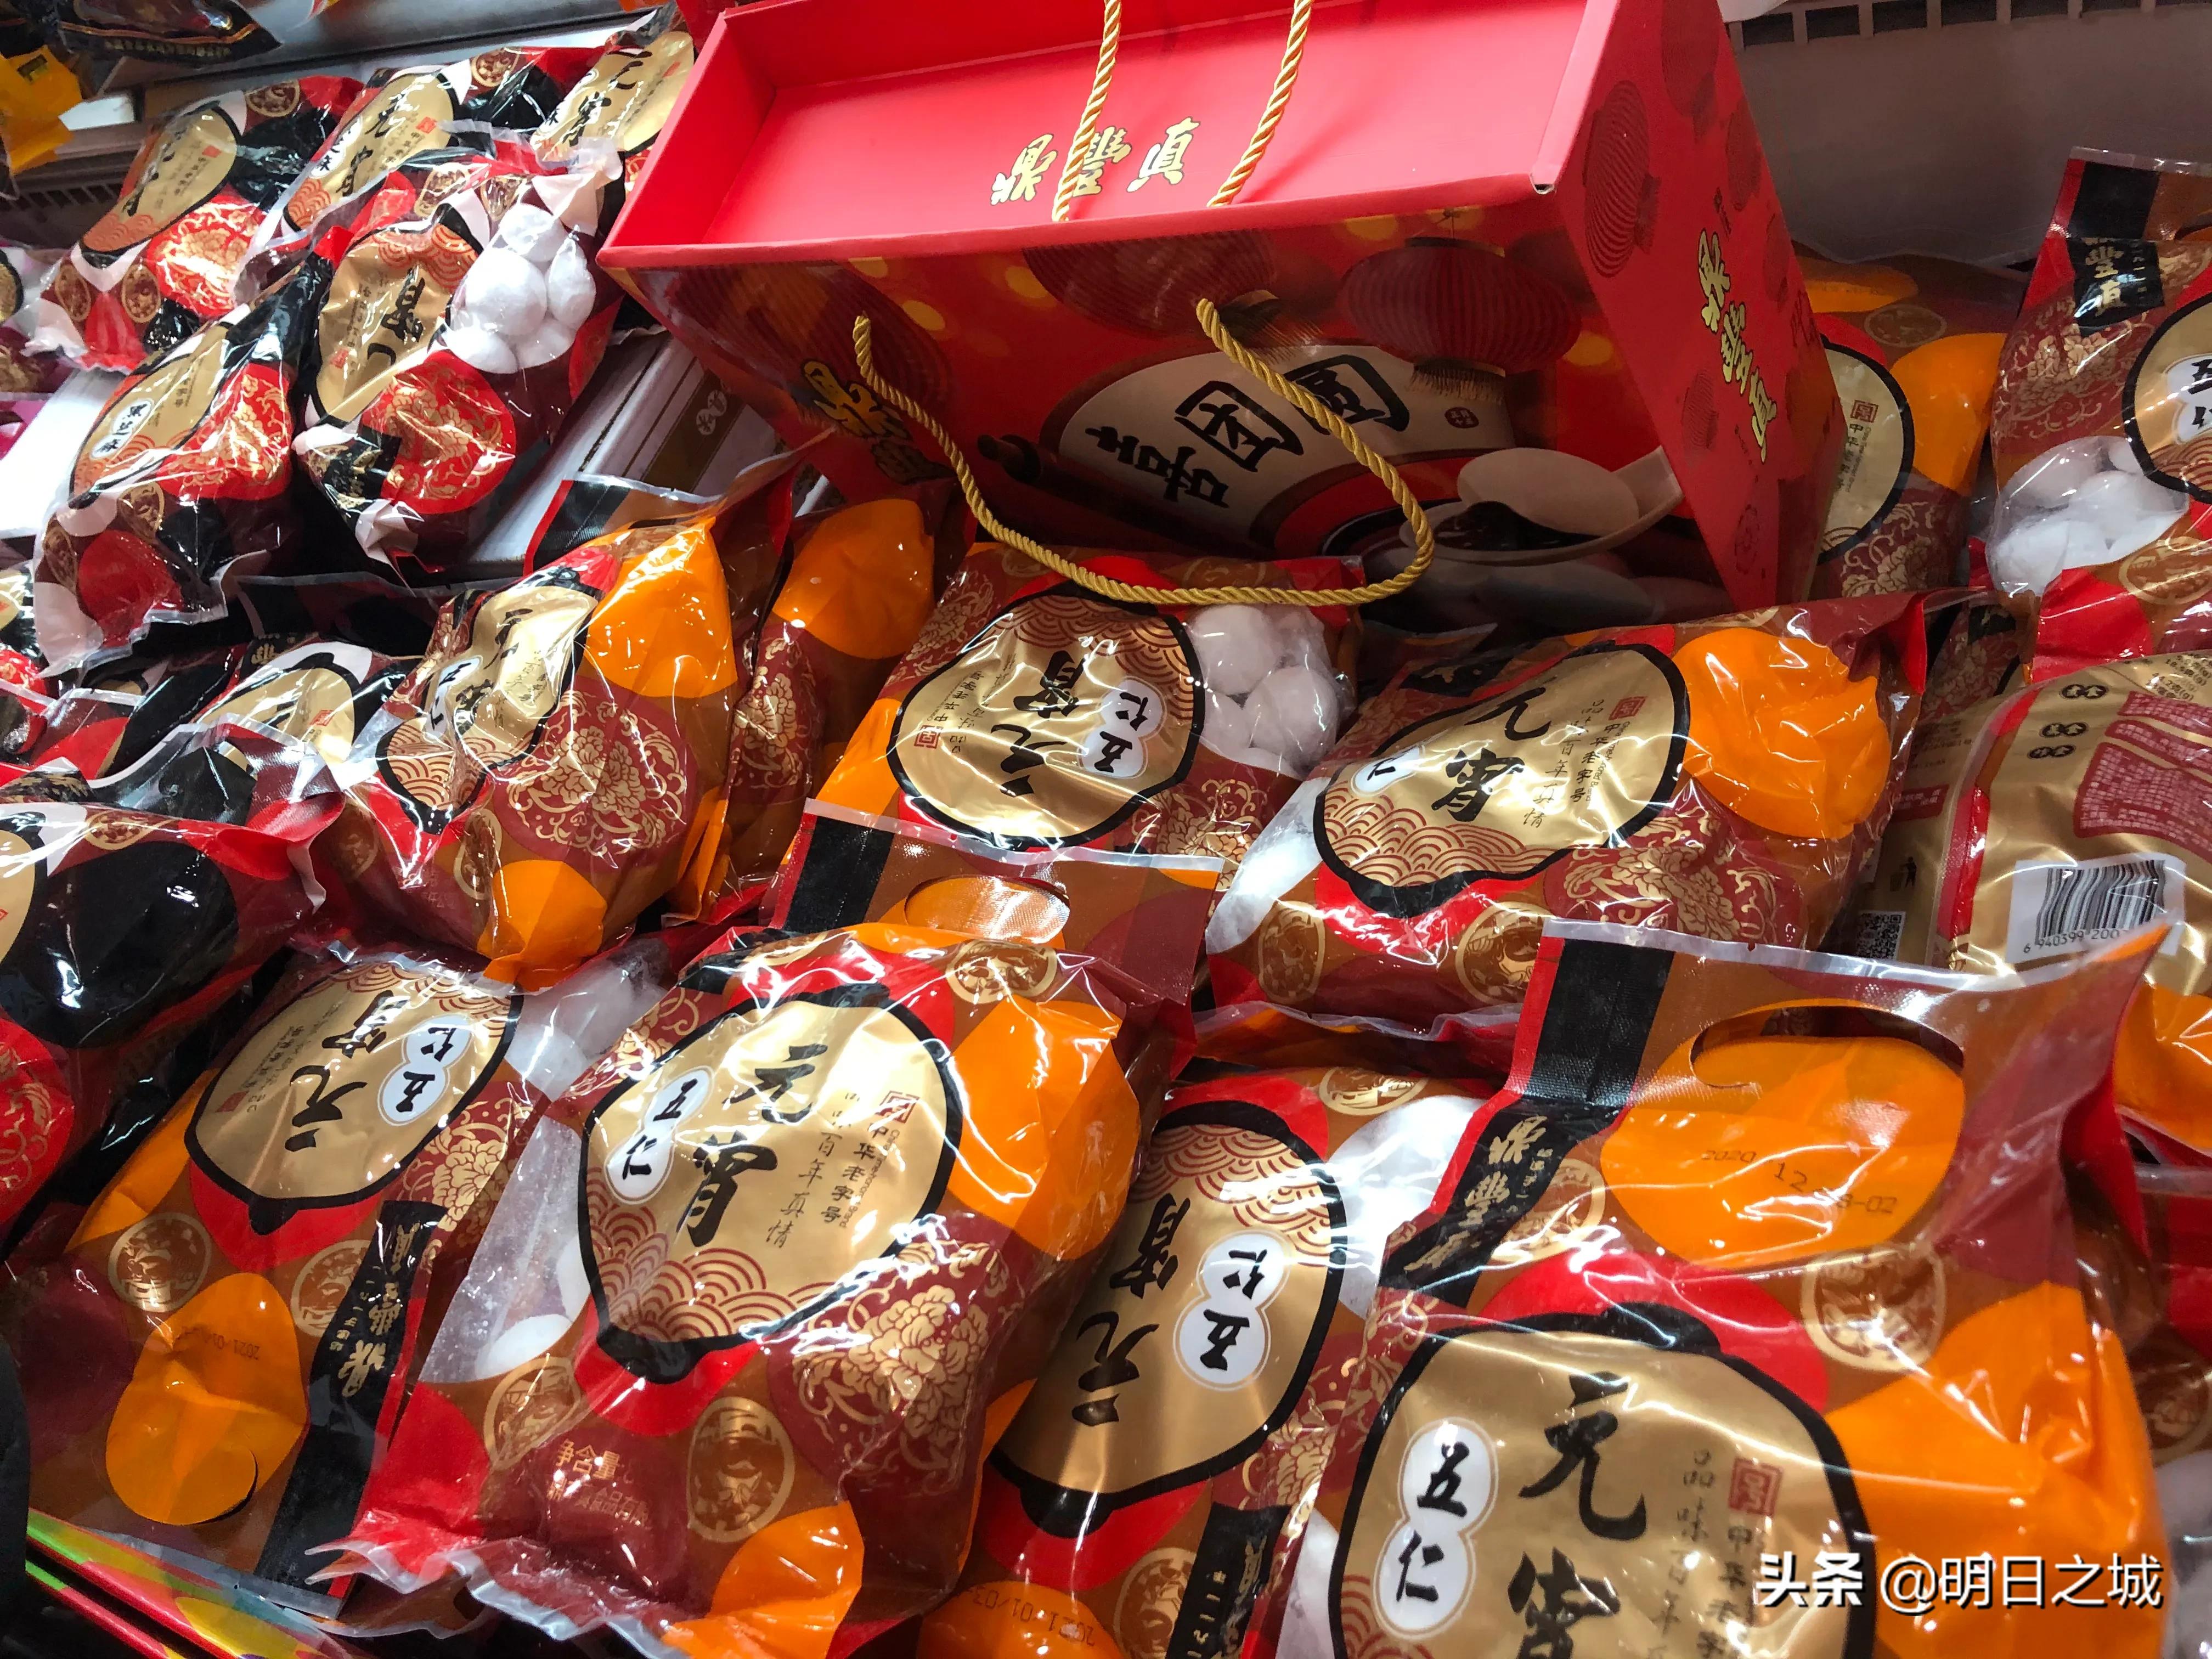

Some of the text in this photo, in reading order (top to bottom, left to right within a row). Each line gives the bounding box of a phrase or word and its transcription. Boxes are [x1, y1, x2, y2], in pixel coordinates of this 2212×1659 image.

[989, 649, 1086, 799] 元宵
[1093, 690, 1151, 774] 五仁
[1570, 723, 1621, 803] 中华老字号
[2022, 942, 2031, 955] 6
[395, 1026, 457, 1113] 五仁
[622, 1076, 699, 1181] 五仁
[675, 1043, 829, 1248] 元宵
[766, 1092, 860, 1249] 百年真情
[820, 1123, 890, 1224] 中华老字号
[1071, 1193, 1190, 1427] 元宵
[1200, 1248, 1269, 1372] 五仁
[1395, 1441, 1471, 1604] 五仁
[1507, 1370, 1648, 1659] 元宵
